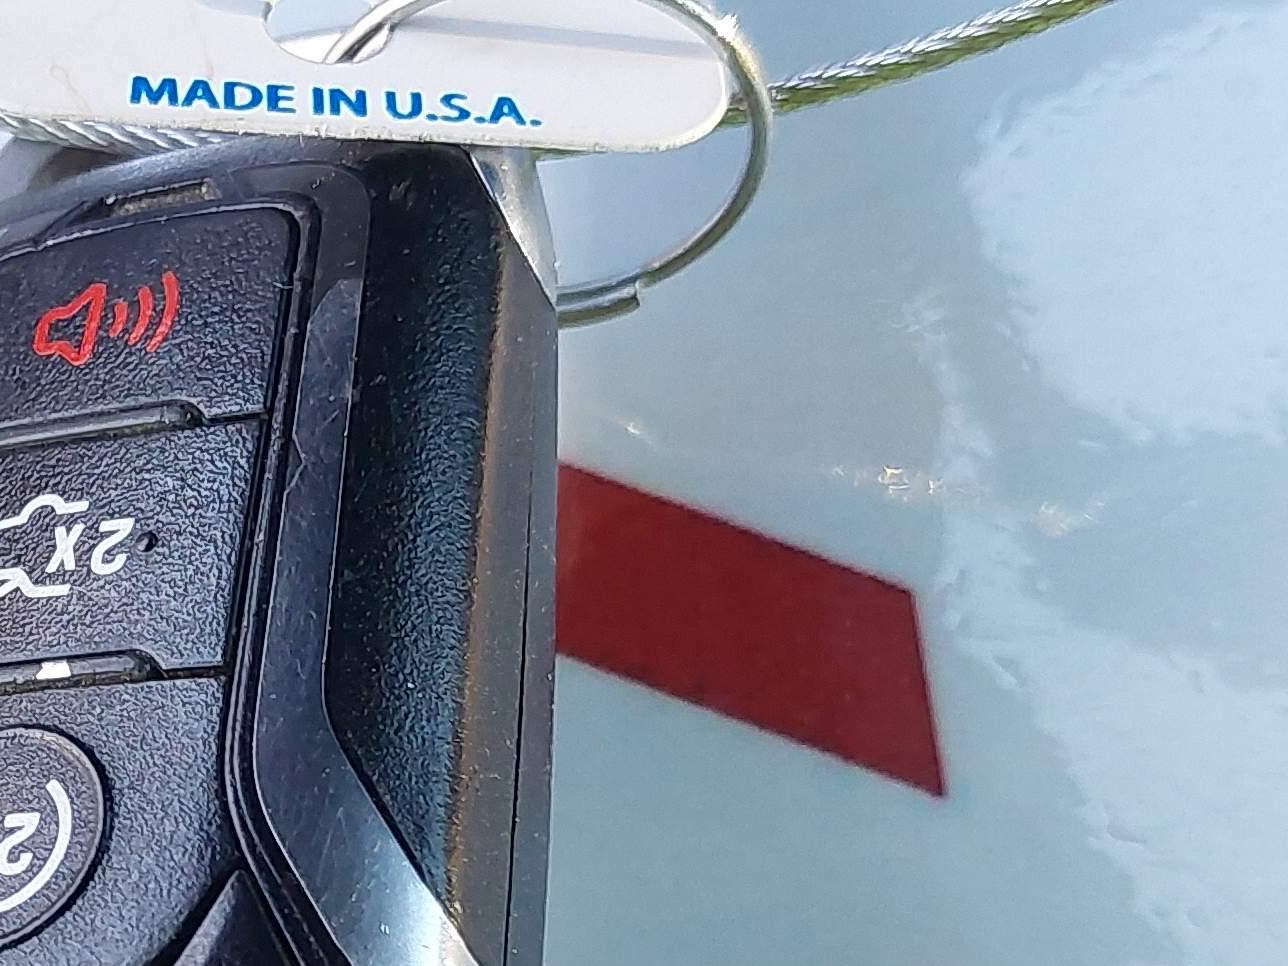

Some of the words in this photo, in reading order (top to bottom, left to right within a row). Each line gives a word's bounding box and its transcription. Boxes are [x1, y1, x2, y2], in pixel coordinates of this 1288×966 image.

[128, 74, 296, 114] MADE
[311, 85, 369, 119] IN
[383, 89, 542, 128] U.S.A.
